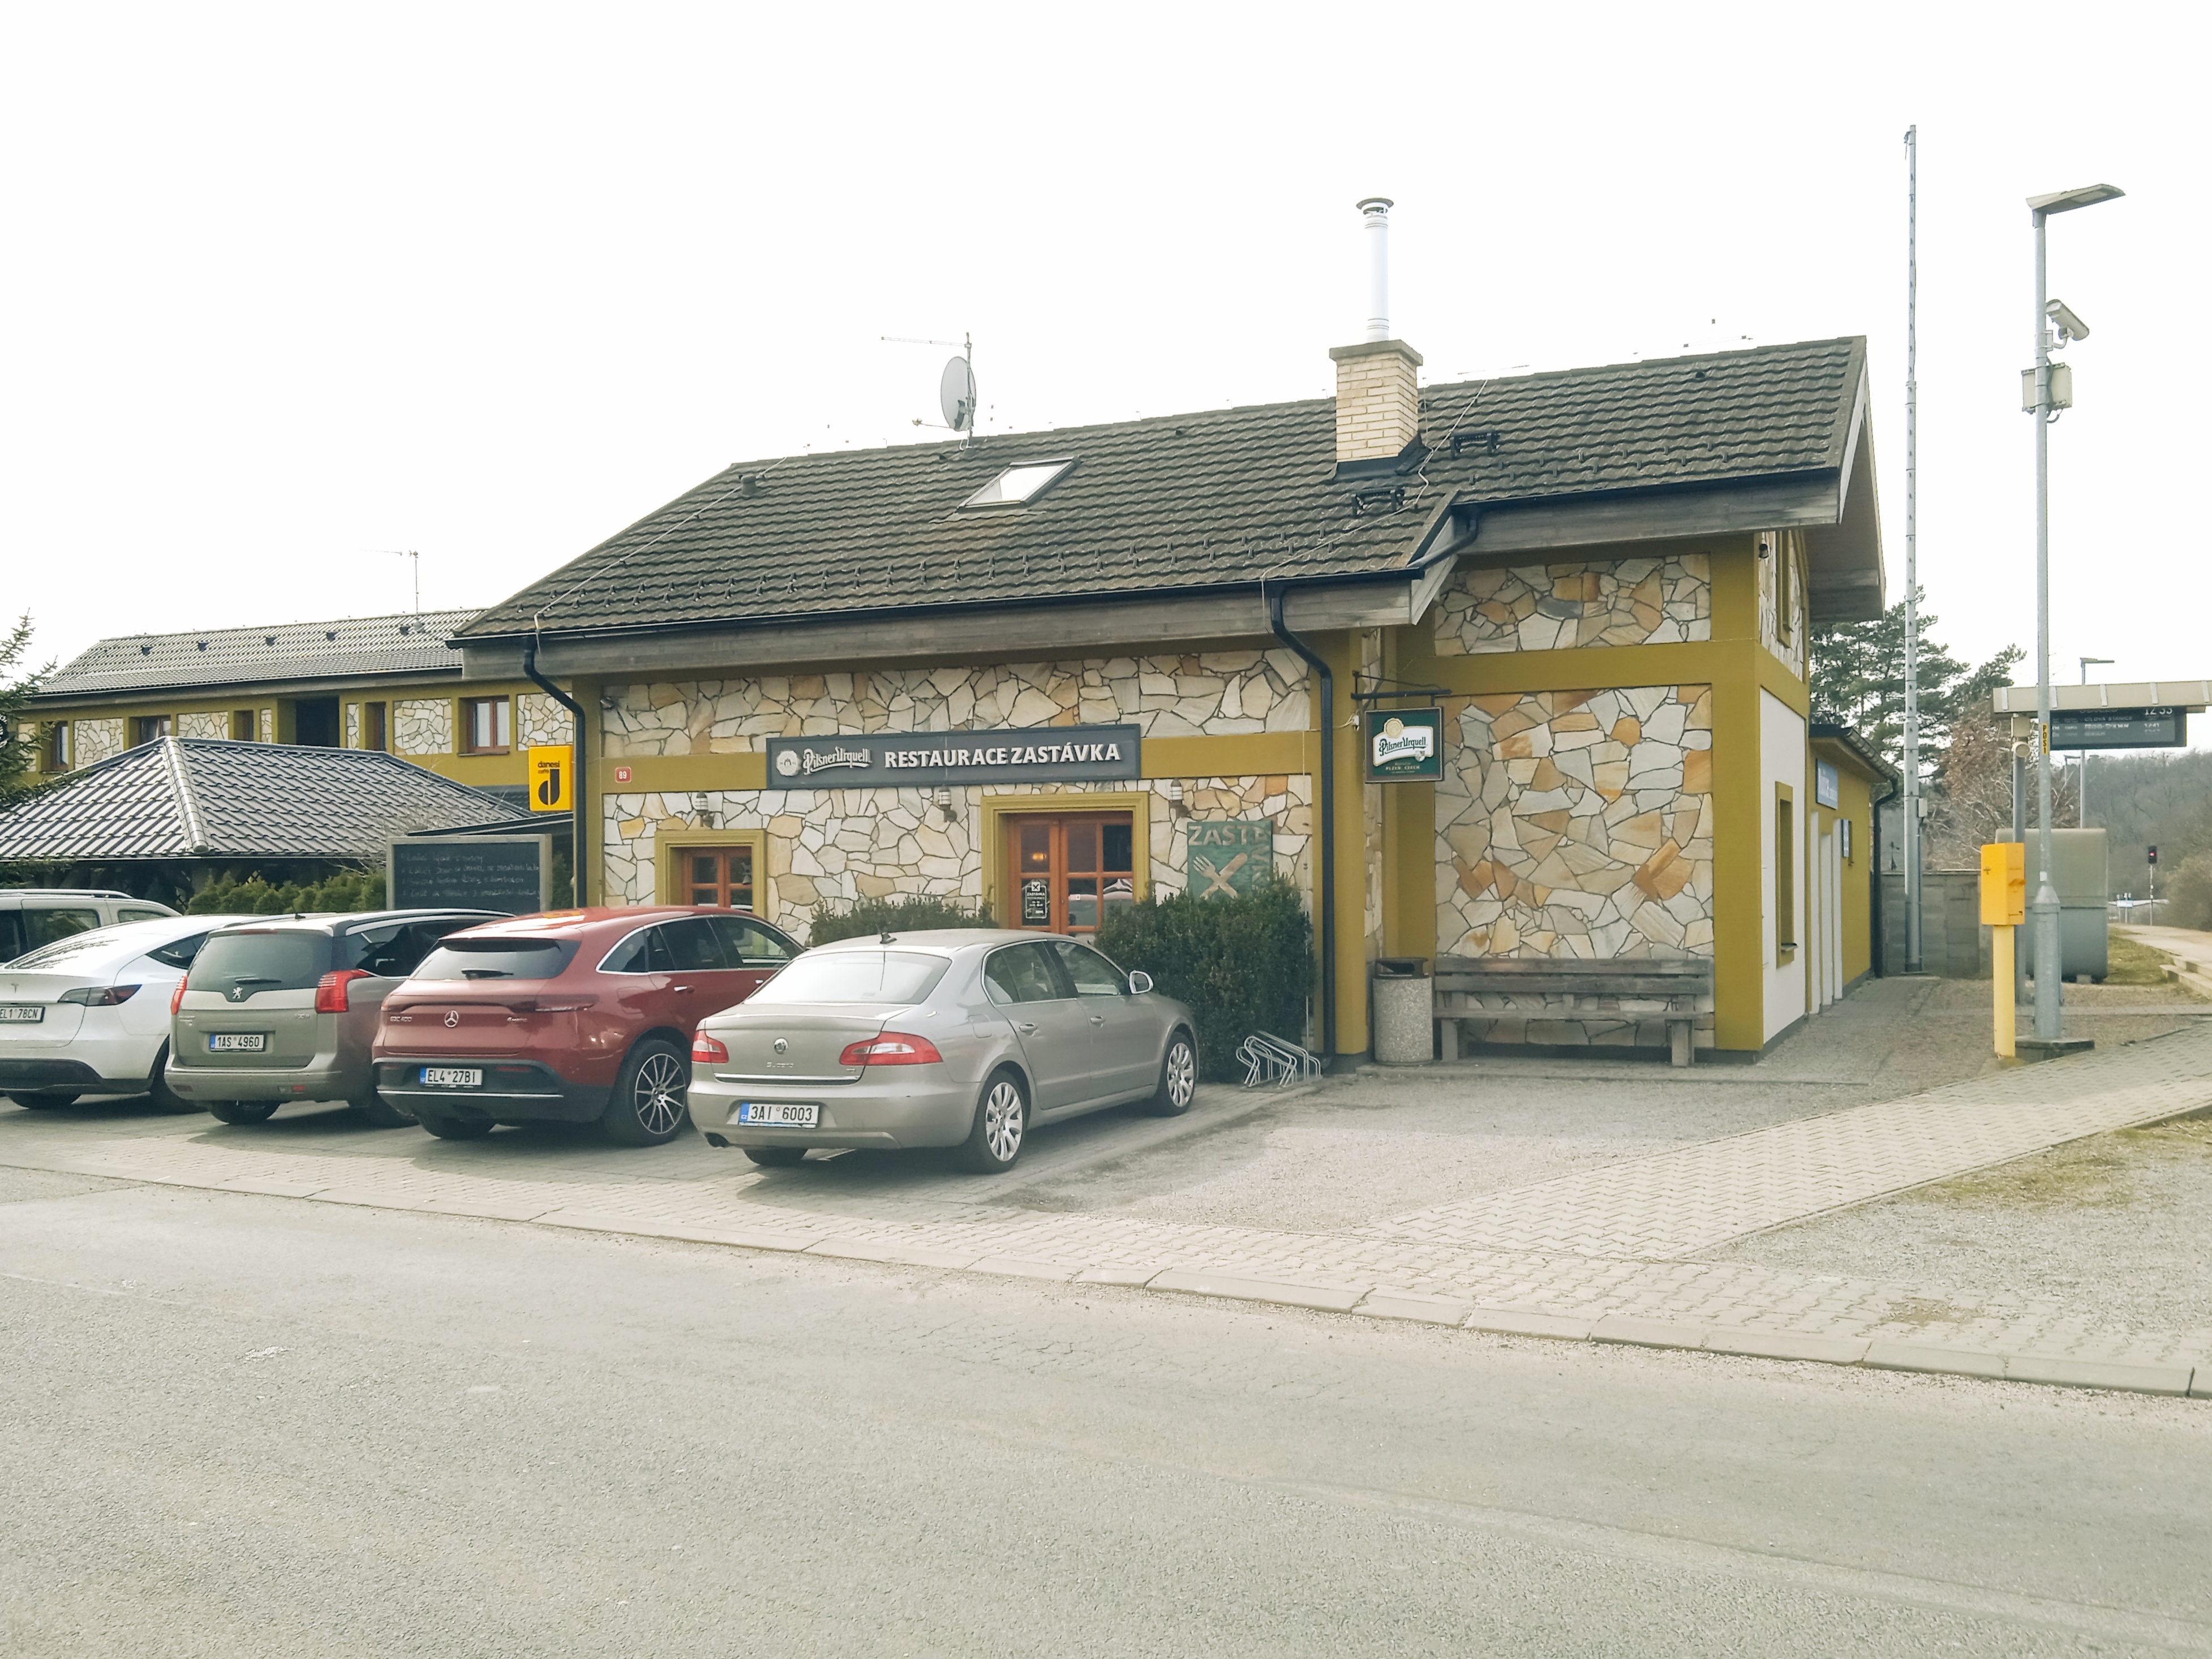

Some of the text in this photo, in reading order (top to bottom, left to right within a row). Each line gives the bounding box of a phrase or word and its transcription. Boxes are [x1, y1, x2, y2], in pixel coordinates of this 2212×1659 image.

[1378, 737, 1426, 757] Pilsner Urquell
[803, 742, 1121, 776] Pilsner Urquell RESTAURACE ZASTÁVKA
[618, 770, 627, 780] 89
[0, 1008, 38, 1018] EL1 78CN
[217, 1036, 260, 1047] 1AS 4960
[428, 1070, 475, 1083] EL4 27BI
[750, 1106, 771, 1120] 3AI
[782, 1107, 813, 1121] 6003
